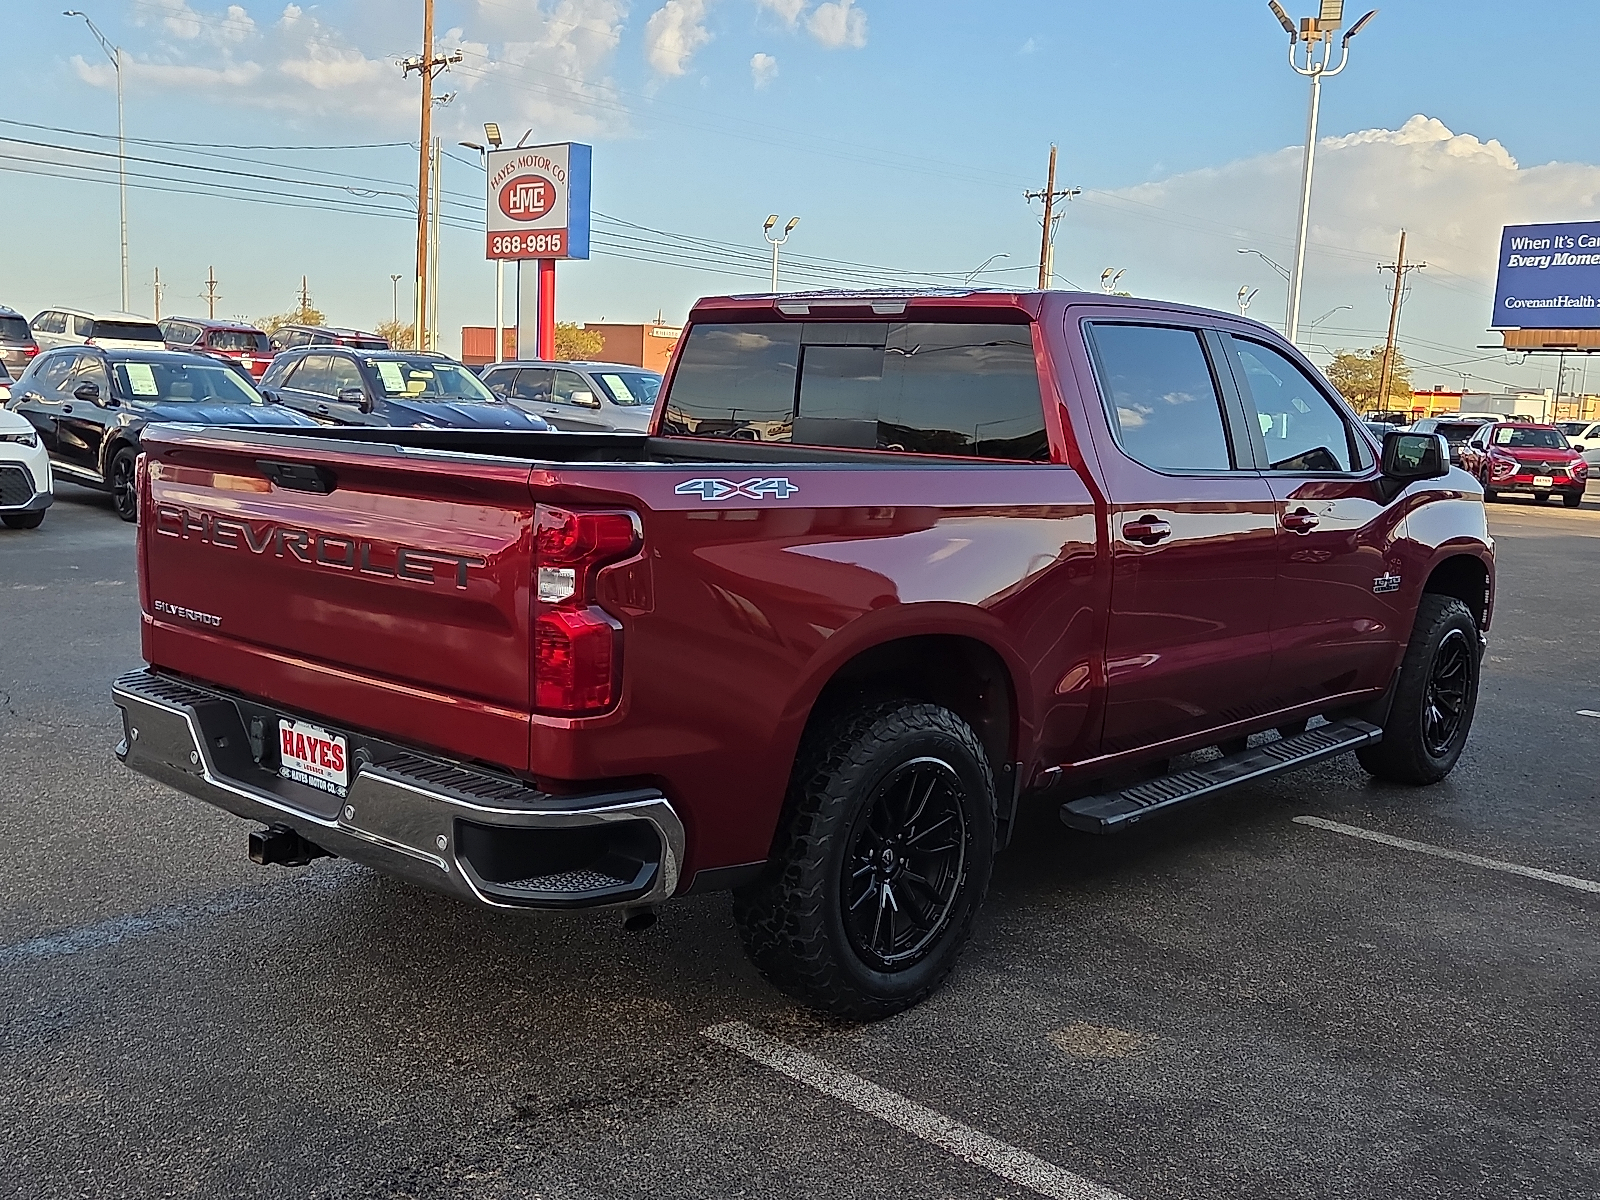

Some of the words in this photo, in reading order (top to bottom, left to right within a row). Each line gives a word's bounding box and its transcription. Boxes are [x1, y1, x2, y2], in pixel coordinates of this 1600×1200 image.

[490, 160, 516, 190] HAYES
[517, 155, 551, 172] MOTOR
[552, 164, 566, 186] CO.
[492, 233, 562, 255] 368-9815
[1511, 237, 1550, 250] When
[1554, 235, 1575, 249] It's
[1507, 254, 1551, 269] Every
[1552, 252, 1600, 266] Mome
[1504, 295, 1595, 309] CovenantHealth
[156, 504, 486, 591] CHEVROLET
[154, 600, 222, 627] SILVERADO
[282, 728, 345, 772] HAYES
[291, 769, 309, 785] HAYES
[308, 775, 327, 791] MOTOR
